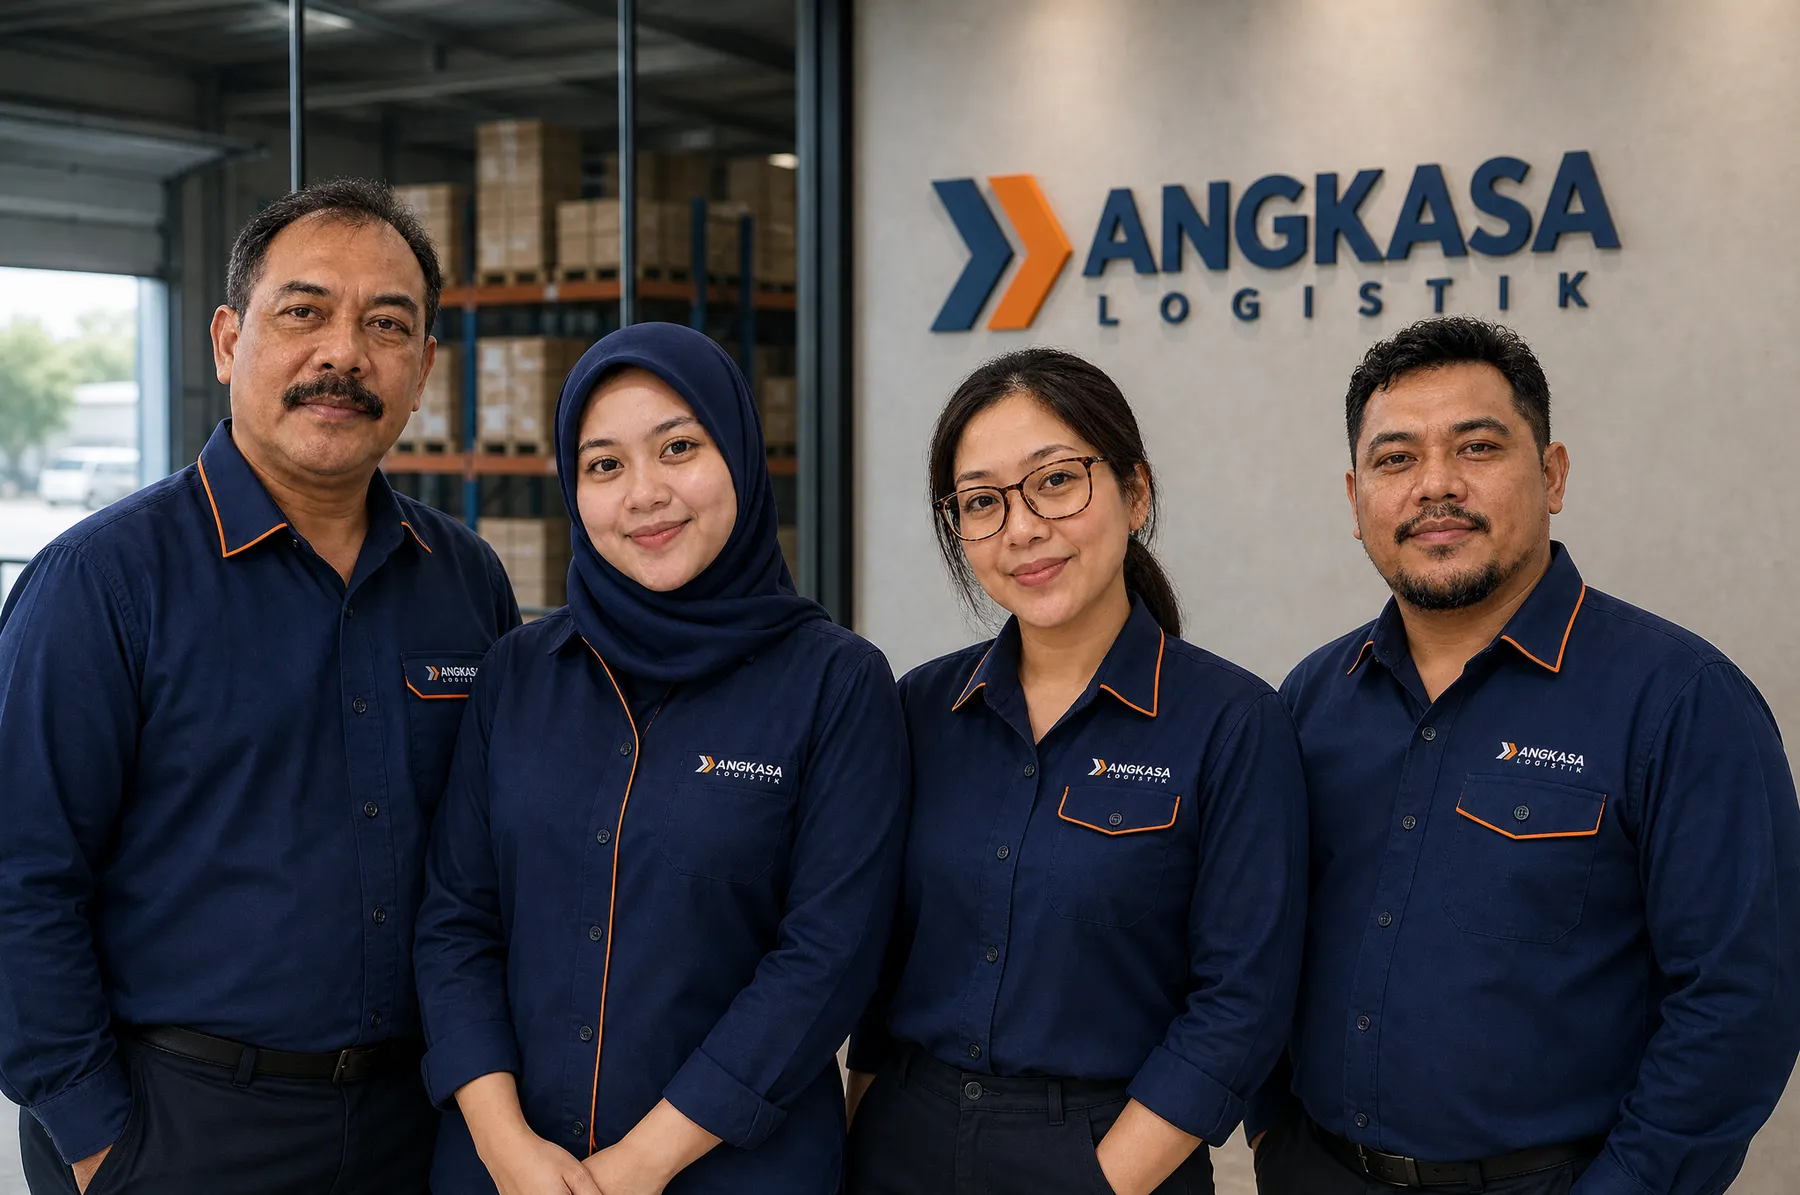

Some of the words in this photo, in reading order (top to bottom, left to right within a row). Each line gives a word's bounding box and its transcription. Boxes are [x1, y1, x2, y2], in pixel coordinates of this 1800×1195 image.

[1083, 151, 1621, 277] ANGKASA
[1099, 271, 1589, 327] LOGISTIK
[1518, 746, 1584, 766] ANGKASA
[716, 760, 782, 777] ANGKASA
[1107, 763, 1170, 777] ANGKASA
[1516, 758, 1582, 773] LOGISTIK
